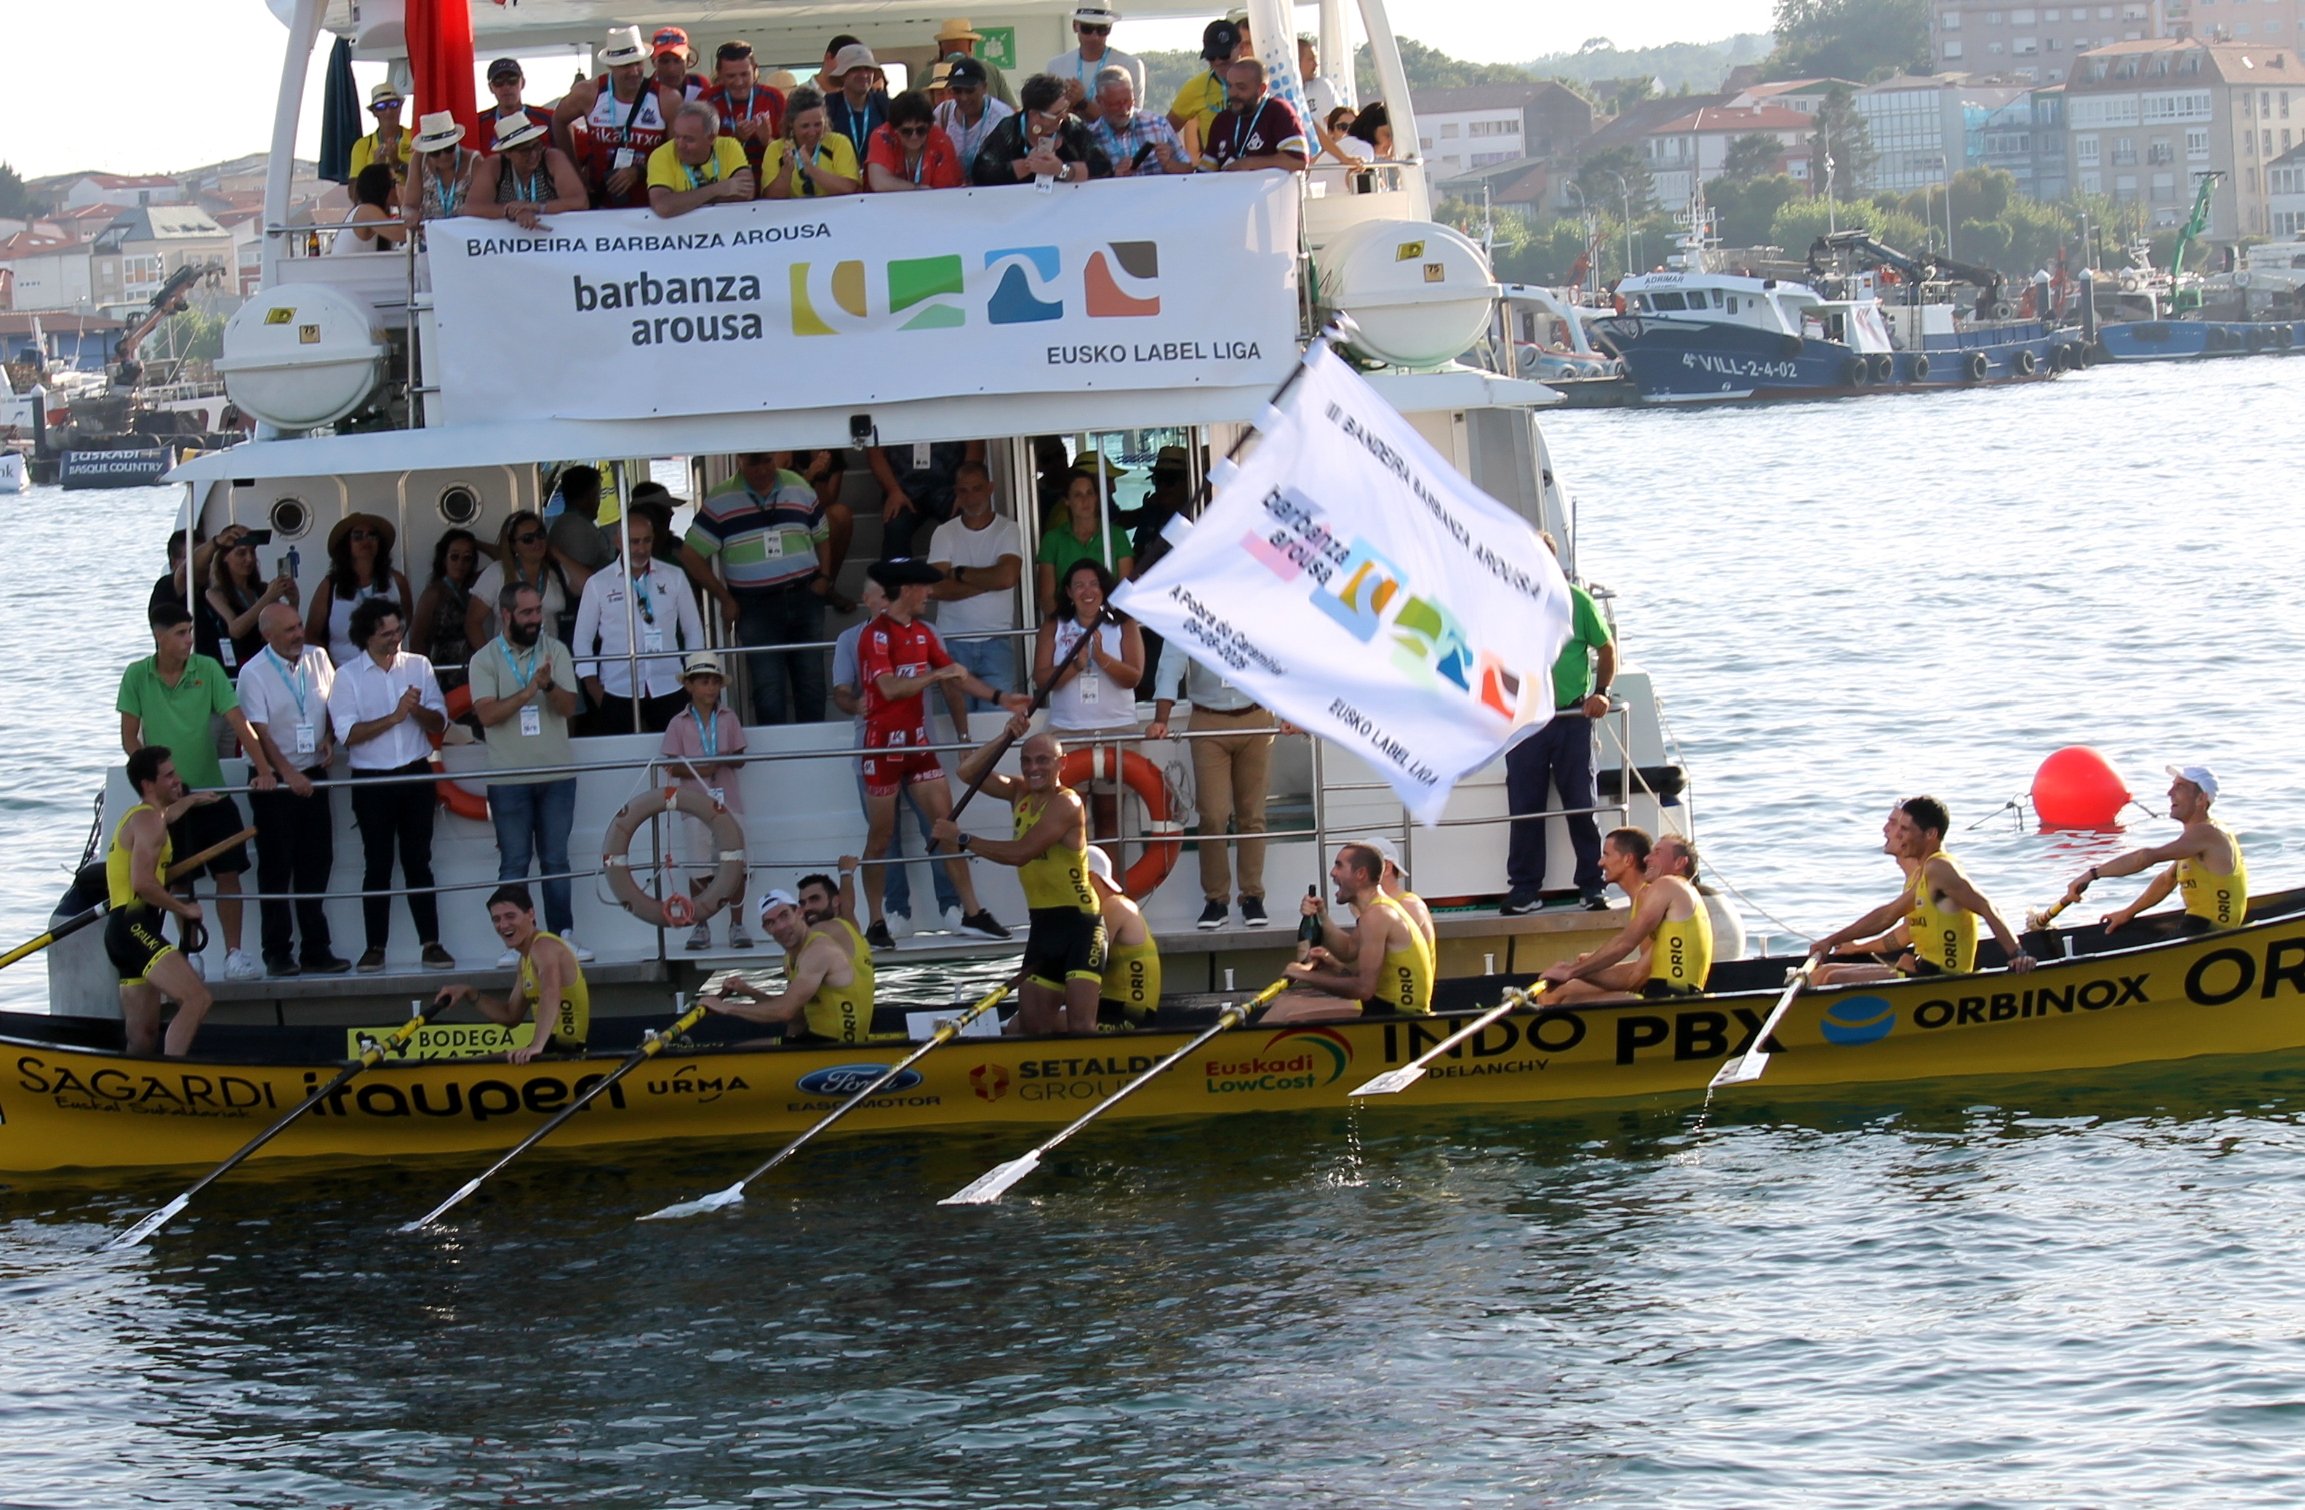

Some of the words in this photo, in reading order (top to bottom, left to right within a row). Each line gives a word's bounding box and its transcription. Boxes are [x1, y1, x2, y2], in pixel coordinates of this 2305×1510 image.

[466, 237, 587, 256] BANDEIRA
[596, 233, 725, 252] BARBANZA
[732, 222, 831, 246] AROUSA
[573, 271, 761, 312] barbanza
[631, 312, 763, 346] arousa
[1047, 345, 1127, 364] EUSKO
[1134, 342, 1207, 362] LABEL
[1213, 341, 1262, 360] LIGA
[69, 463, 108, 475] BASQUE
[110, 461, 163, 474] COUNTRY
[71, 450, 140, 463] EUSKADI
[1261, 484, 1350, 566] barbanza
[1342, 415, 1410, 484] BANDEIRA
[1412, 476, 1470, 551] BARBANZA
[1474, 542, 1542, 600] AROUSA
[1269, 529, 1332, 587] arousa
[1328, 697, 1373, 736] EUSKO
[1371, 728, 1410, 769] LABEL
[1408, 760, 1440, 787] LIGA
[1068, 867, 1093, 905] ORIO
[2216, 889, 2231, 924] ORIO
[1669, 936, 1684, 979] ORIO
[1943, 929, 1957, 969] ORIO
[1129, 960, 1144, 1001] ORIO
[1398, 966, 1414, 1006] ORIO
[560, 999, 575, 1036] ORIO
[1912, 973, 2152, 1030] ORBINOX
[419, 1028, 514, 1047] BODEGA
[840, 1001, 856, 1043] ORIO
[1384, 1011, 1586, 1064] INDO
[1616, 1005, 1788, 1066] PBX
[17, 1056, 277, 1110] SAGARDI
[1205, 1054, 1313, 1077] Euskadi
[1206, 1073, 1316, 1094] LowCost
[1428, 1059, 1550, 1080] DELANCHY
[303, 1072, 626, 1121] iraupen
[647, 1076, 751, 1096] URMA
